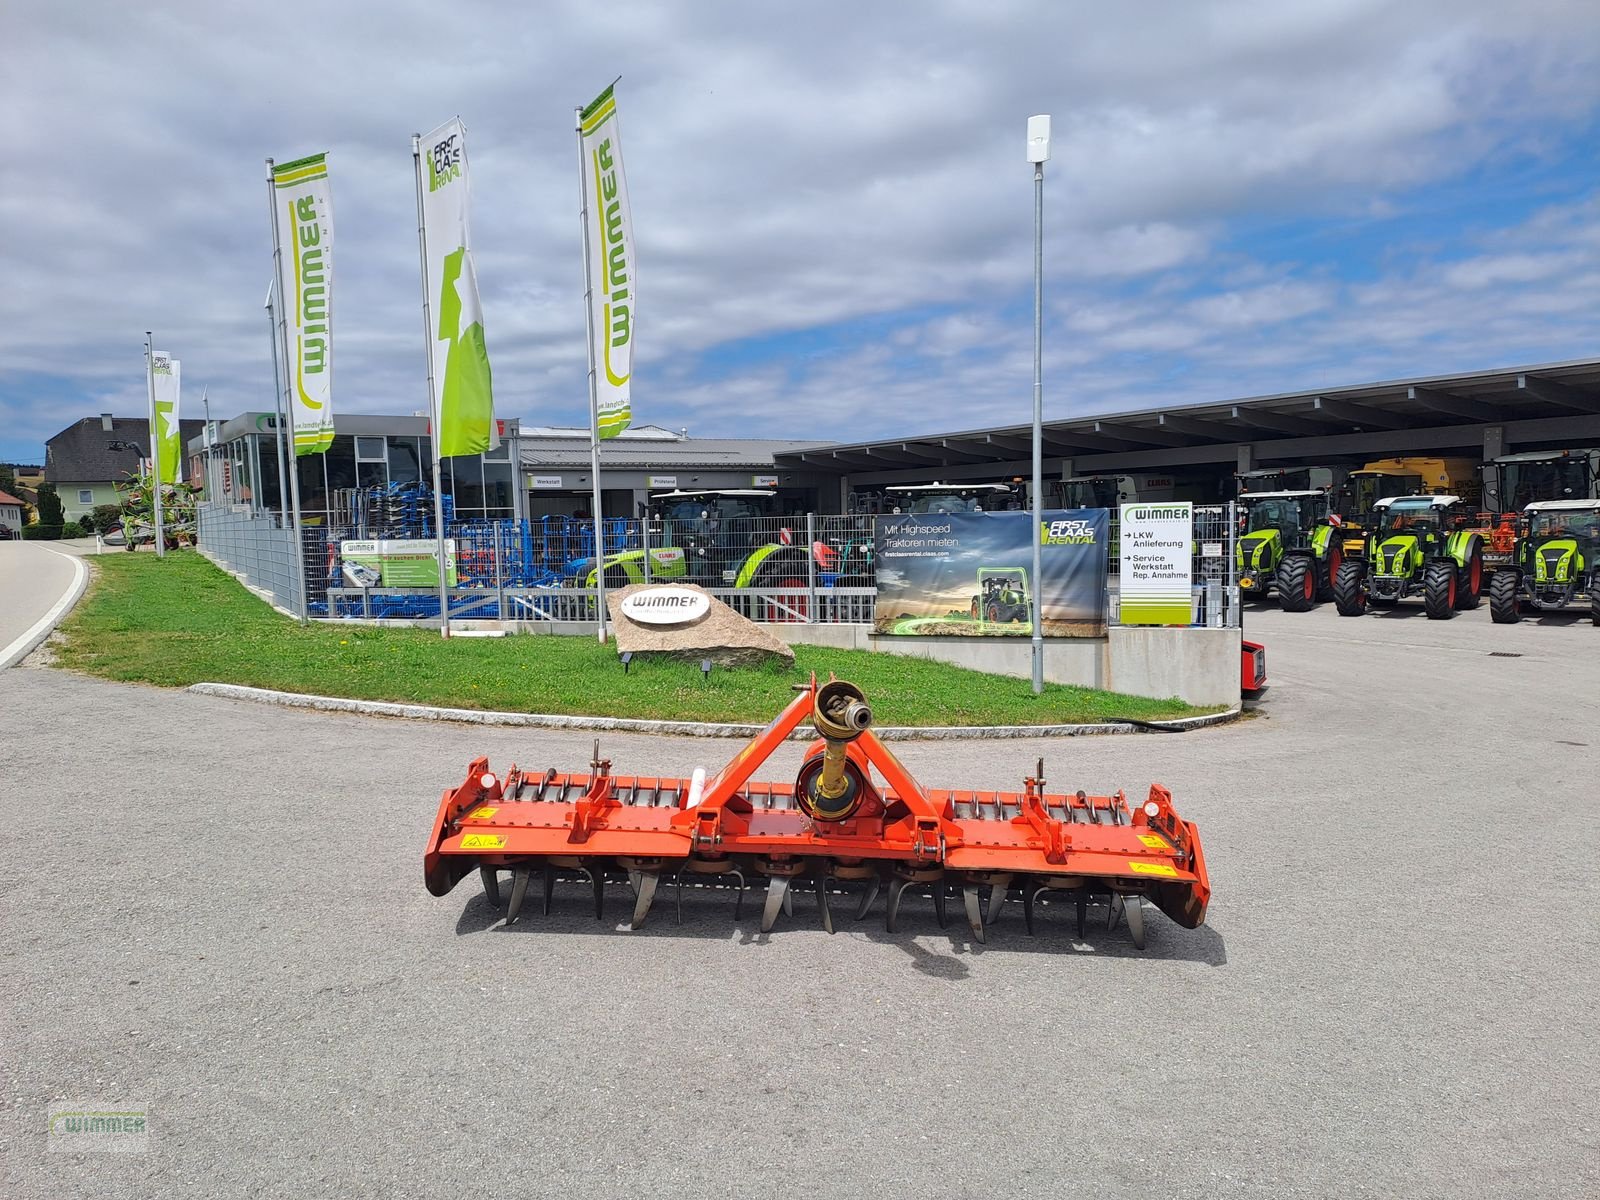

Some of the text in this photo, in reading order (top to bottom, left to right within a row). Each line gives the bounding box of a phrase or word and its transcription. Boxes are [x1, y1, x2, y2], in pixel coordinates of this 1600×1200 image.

[598, 137, 630, 348] WIMMER
[297, 194, 326, 374] WIMMER
[1135, 509, 1189, 520] WIMMER
[884, 525, 898, 535] Mit
[1050, 520, 1090, 530] FIRST
[1049, 528, 1095, 536] CLAAS
[884, 538, 925, 548] Traktoren
[1046, 536, 1097, 545] RENTAL
[1133, 540, 1184, 548] Anlieferung
[348, 544, 375, 552] WIMMER
[1133, 572, 1150, 580] Rep.
[633, 596, 698, 607] WIMMER
